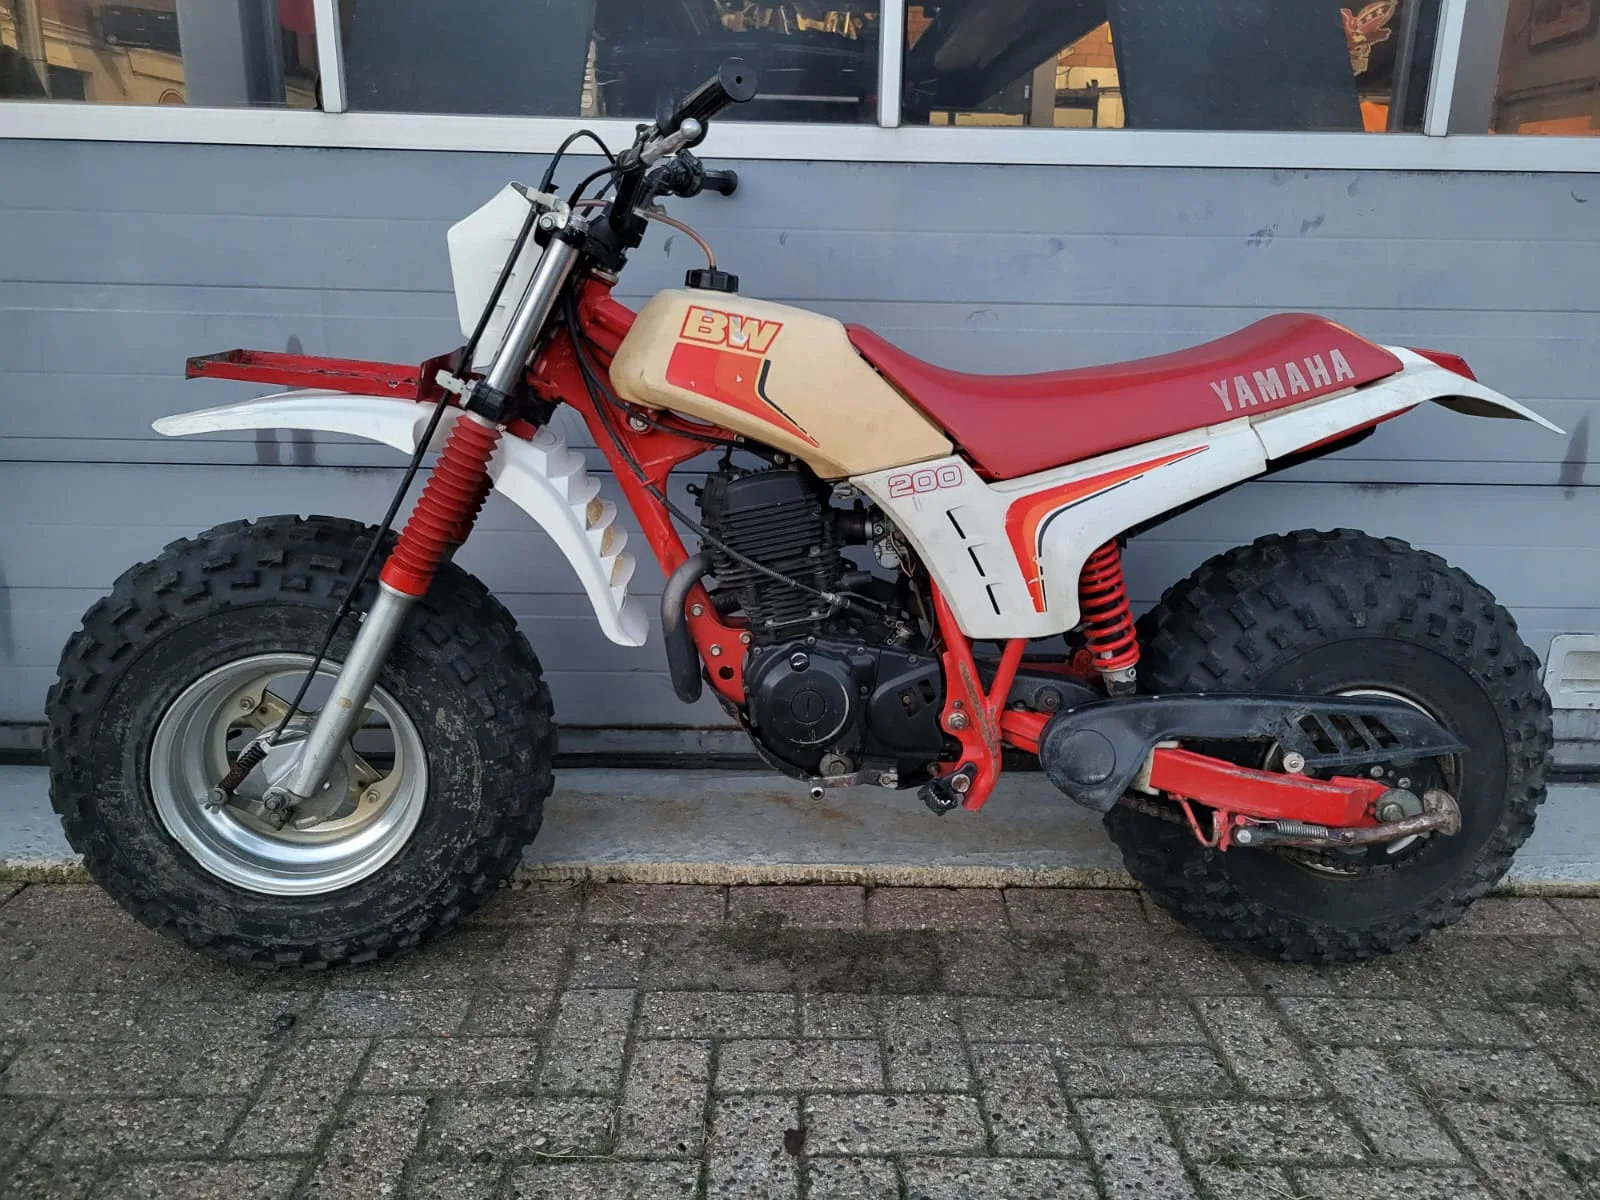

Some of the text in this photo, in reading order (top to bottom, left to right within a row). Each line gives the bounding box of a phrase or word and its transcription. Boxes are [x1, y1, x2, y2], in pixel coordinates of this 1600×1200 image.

[679, 305, 784, 354] BW
[1210, 348, 1355, 412] YAMAHA
[888, 464, 963, 498] 200
